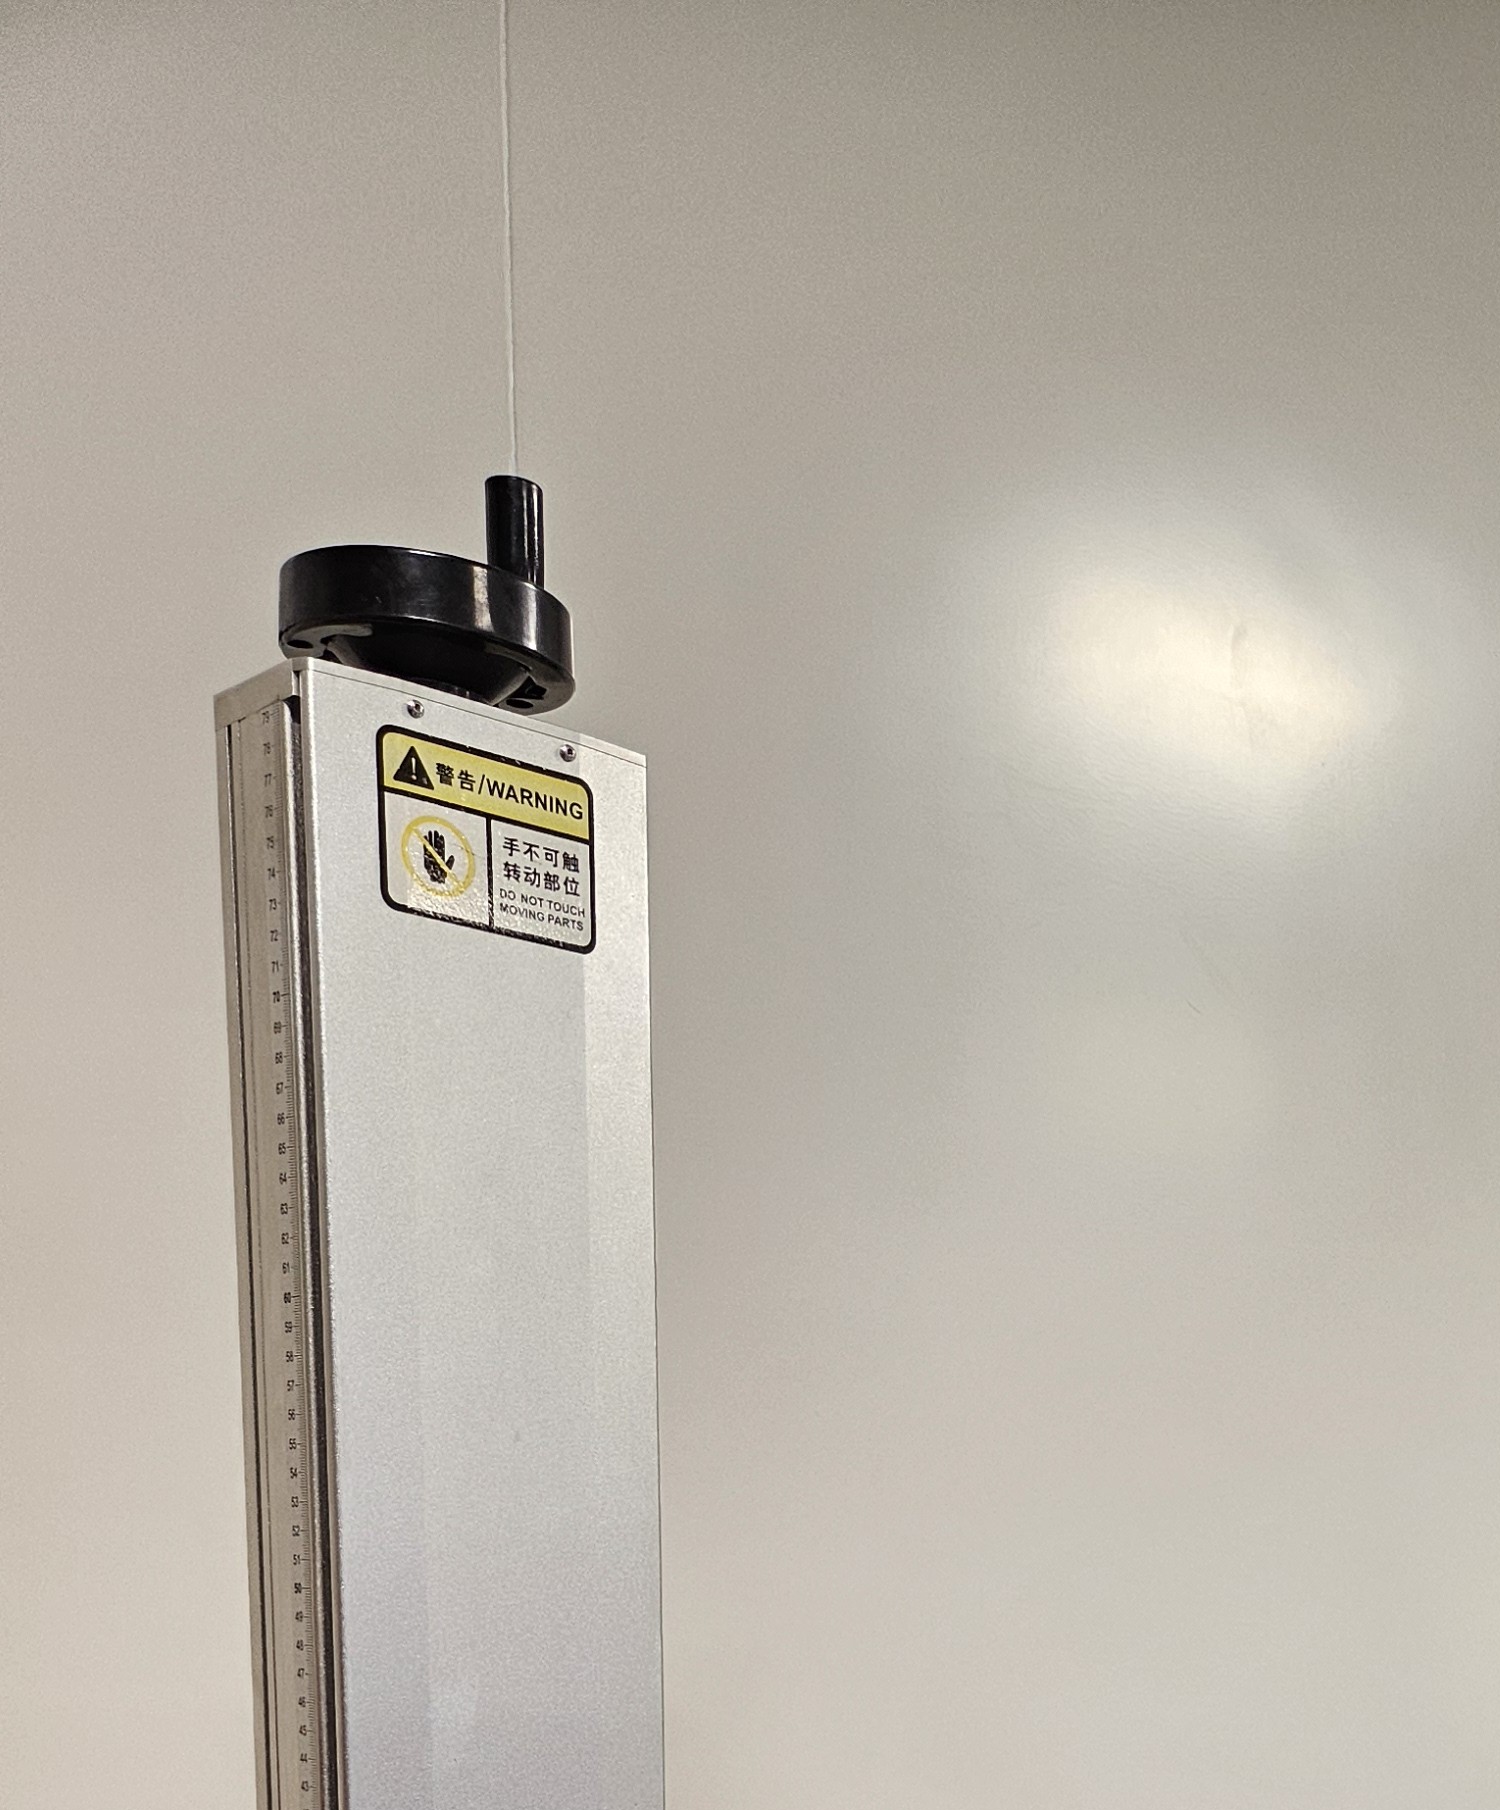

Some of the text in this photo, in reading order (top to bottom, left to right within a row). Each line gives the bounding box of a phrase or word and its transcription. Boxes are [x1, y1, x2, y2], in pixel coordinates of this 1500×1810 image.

[502, 837, 580, 873] 手不可触
[502, 861, 581, 897] 转动部位
[499, 888, 585, 918] DO NOT TOUCH
[499, 903, 584, 932] MOVING PARTS
